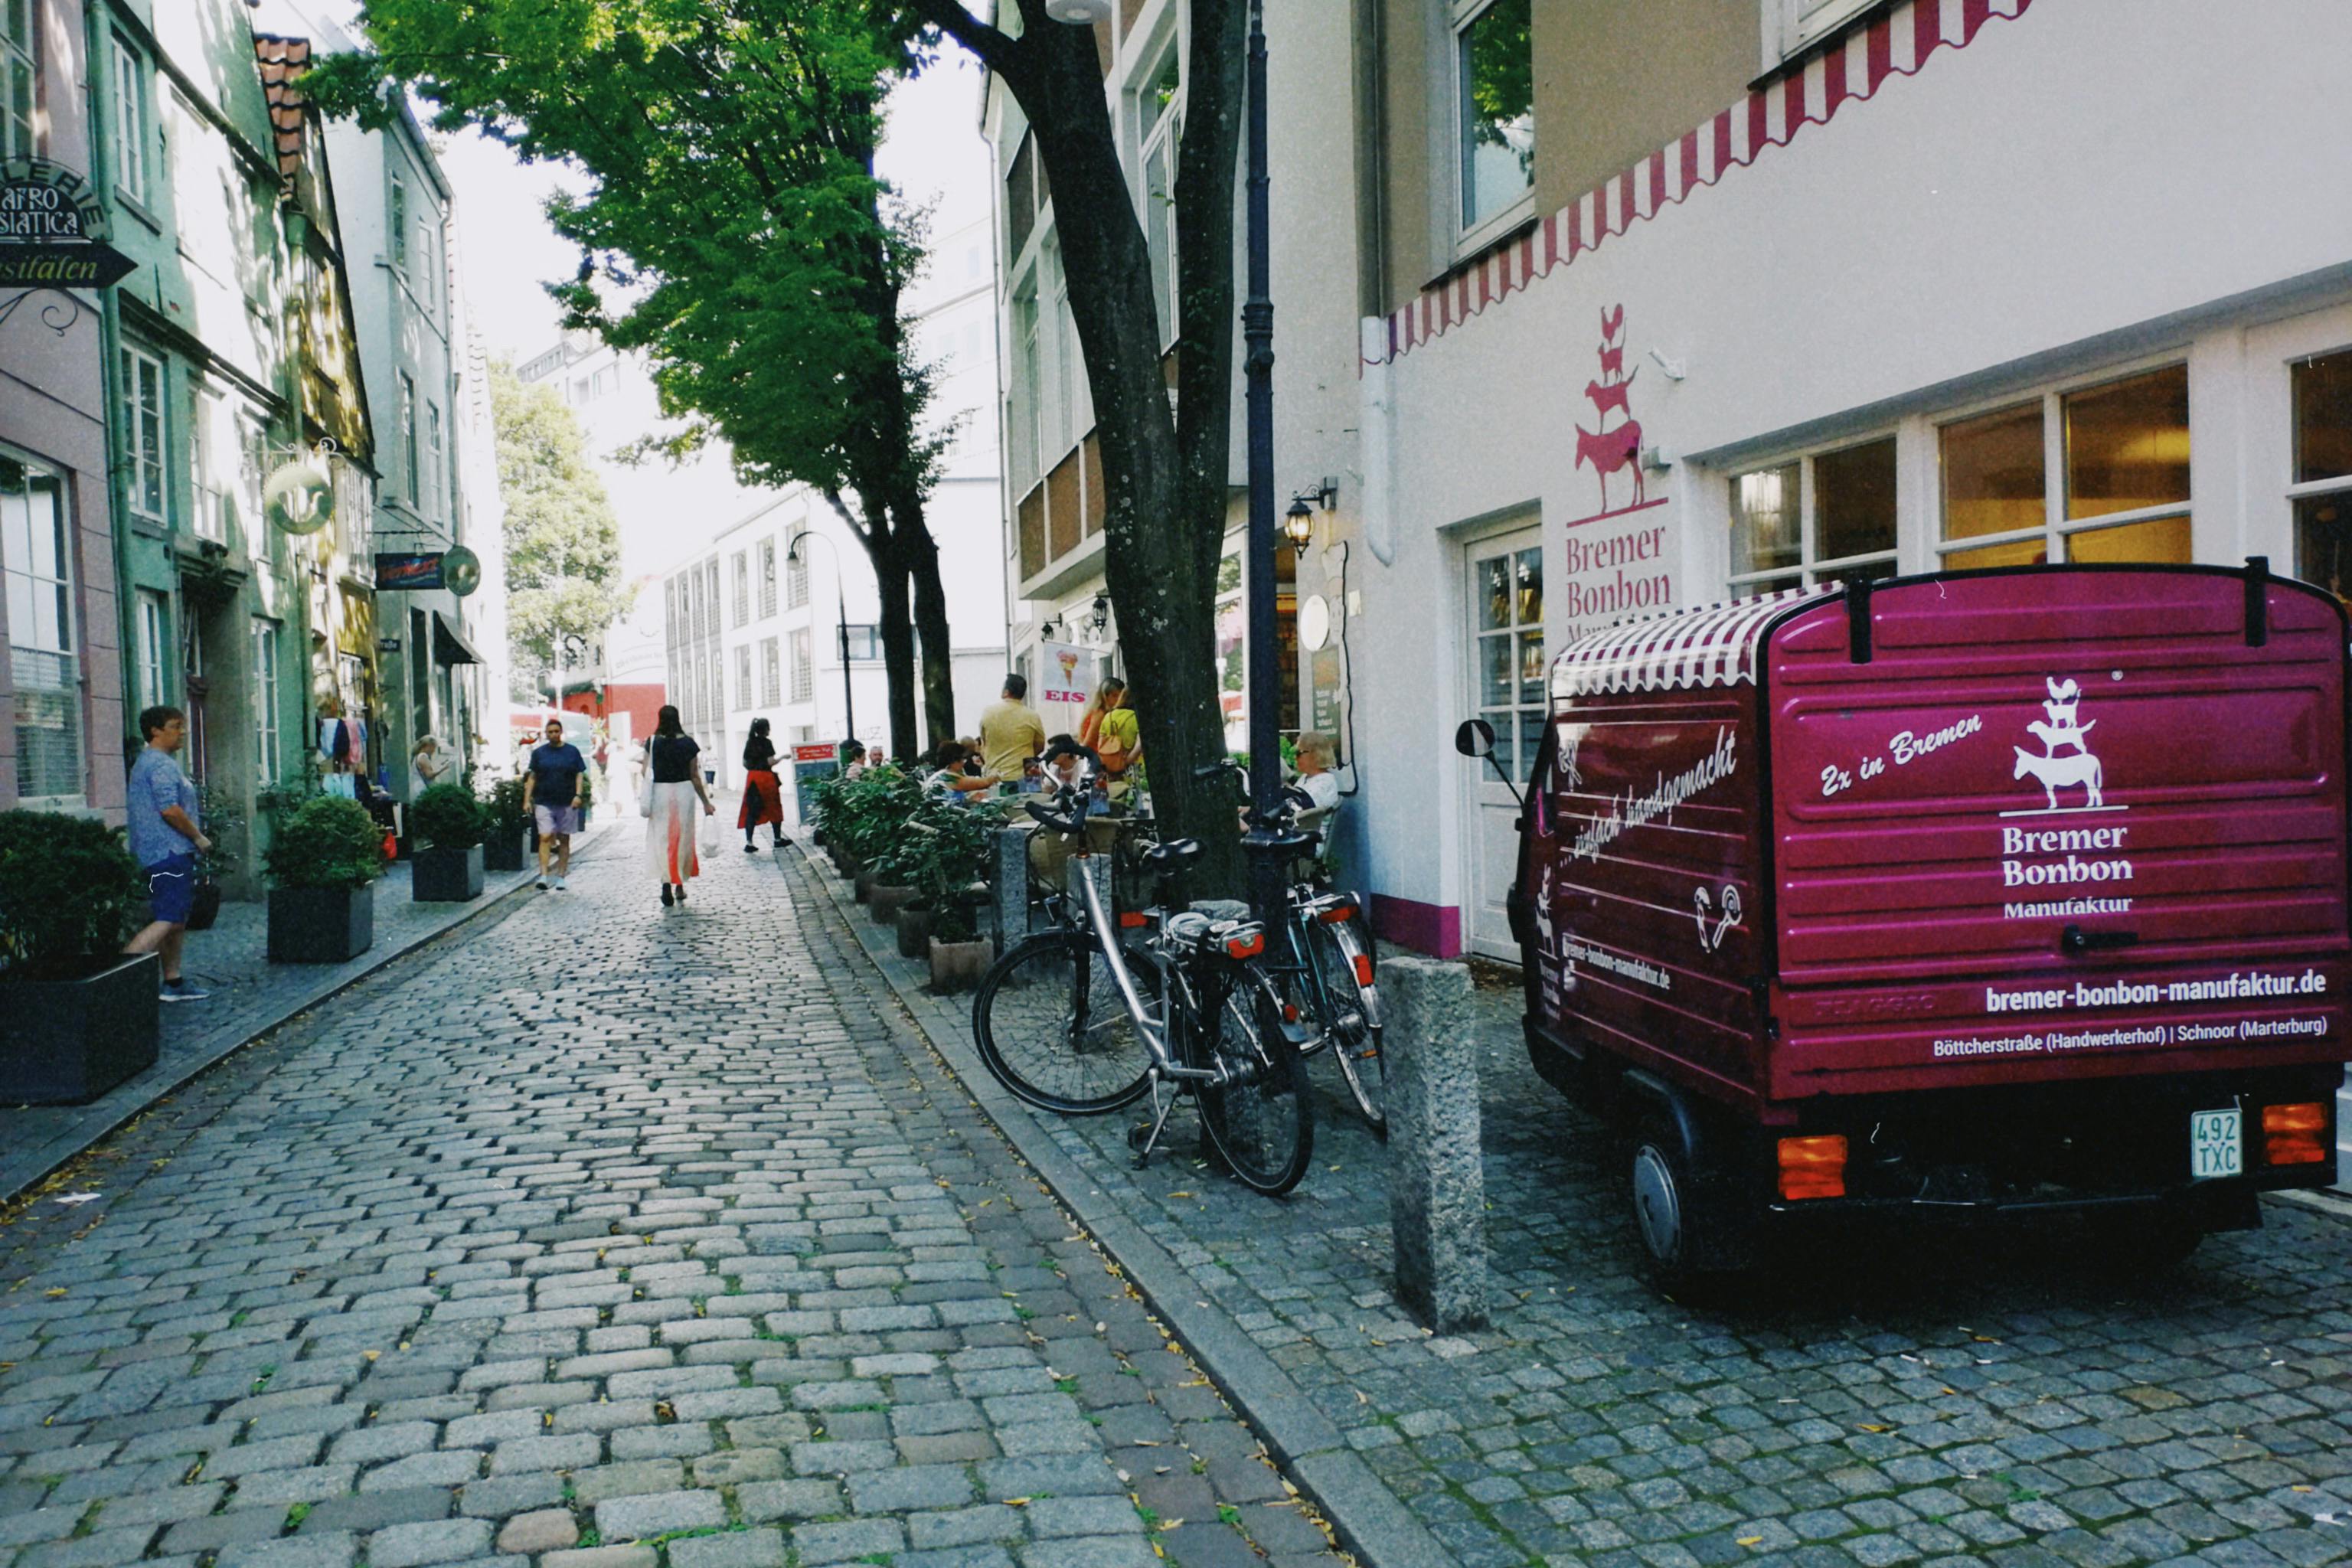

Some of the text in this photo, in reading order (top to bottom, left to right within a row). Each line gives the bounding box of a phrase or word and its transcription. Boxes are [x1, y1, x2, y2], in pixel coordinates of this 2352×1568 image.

[0, 163, 104, 227] LERIE
[2, 188, 59, 210] AFRO
[1566, 526, 1666, 575] Bremer
[1566, 570, 1671, 619] Bonbon
[1045, 690, 1086, 703] EIS
[1821, 714, 1982, 796] 2x in Bremen
[1625, 724, 1737, 829] handgemacht
[2002, 827, 2128, 854] Bremer
[2002, 855, 2134, 887] Bonbon
[2004, 897, 2133, 919] Manufaktur
[1986, 969, 2326, 1012] bremer-bonbon-manufaktur.de
[1934, 1035, 2043, 1057] Böttcherstraße
[2047, 1027, 2166, 1053] (Handwerkerhof)
[2177, 1023, 2236, 1041] Schnoor
[2239, 1016, 2328, 1040] (Marterburg)
[2197, 1116, 2236, 1142] 492
[2200, 1146, 2237, 1172] TXC
